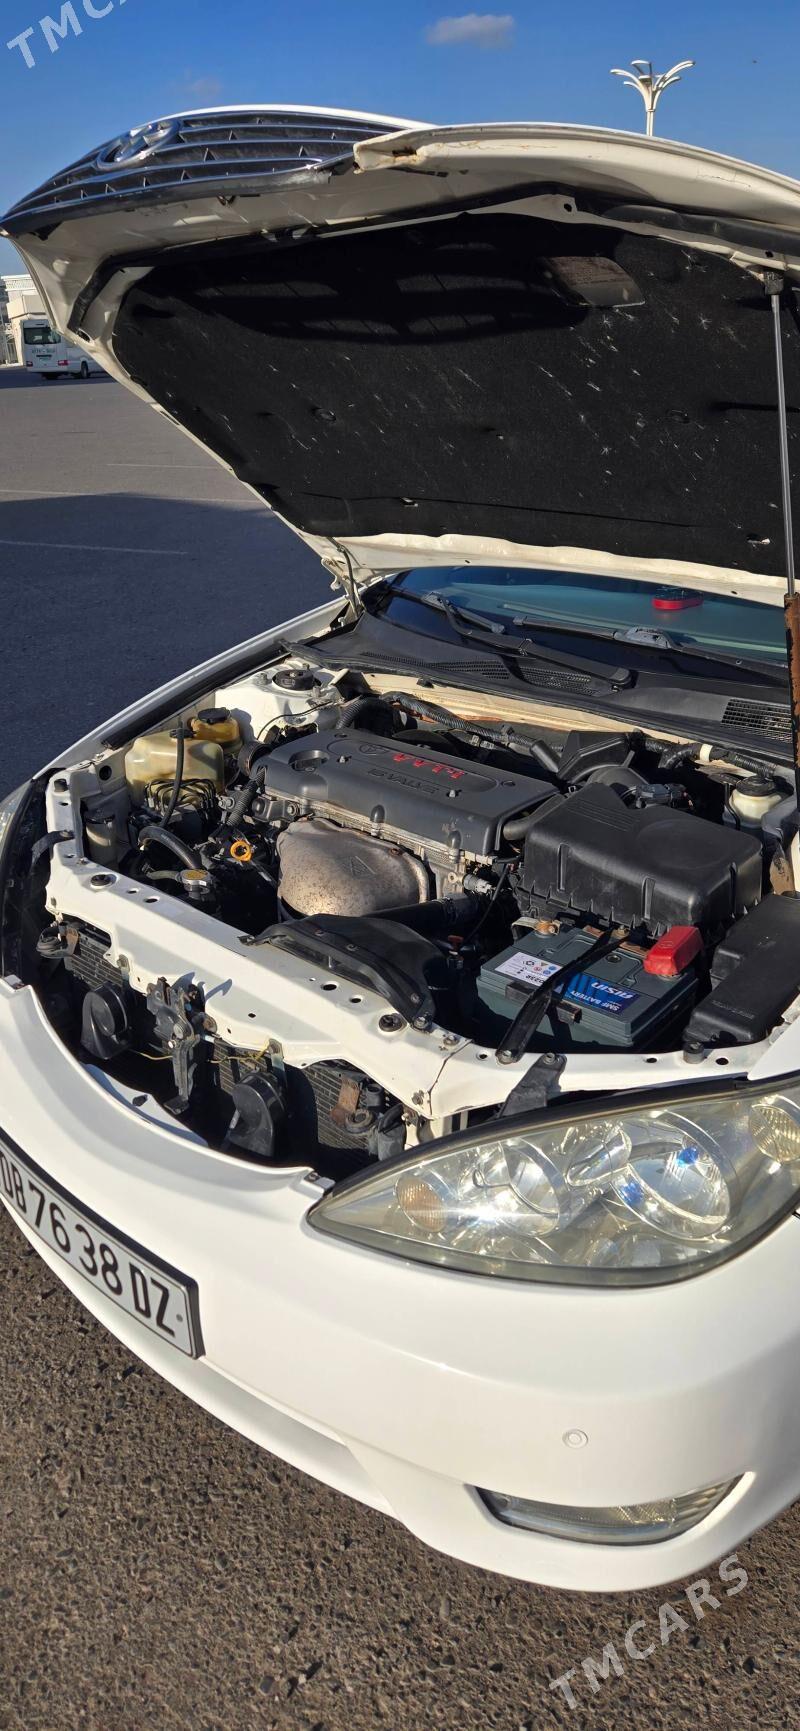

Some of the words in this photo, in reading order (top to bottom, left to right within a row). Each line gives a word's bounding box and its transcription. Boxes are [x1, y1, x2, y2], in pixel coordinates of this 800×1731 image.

[570, 990, 602, 1005] BATTERY
[601, 1002, 620, 1011] SMF
[28, 1179, 123, 1297] 7638
[129, 1262, 176, 1338] DZ
